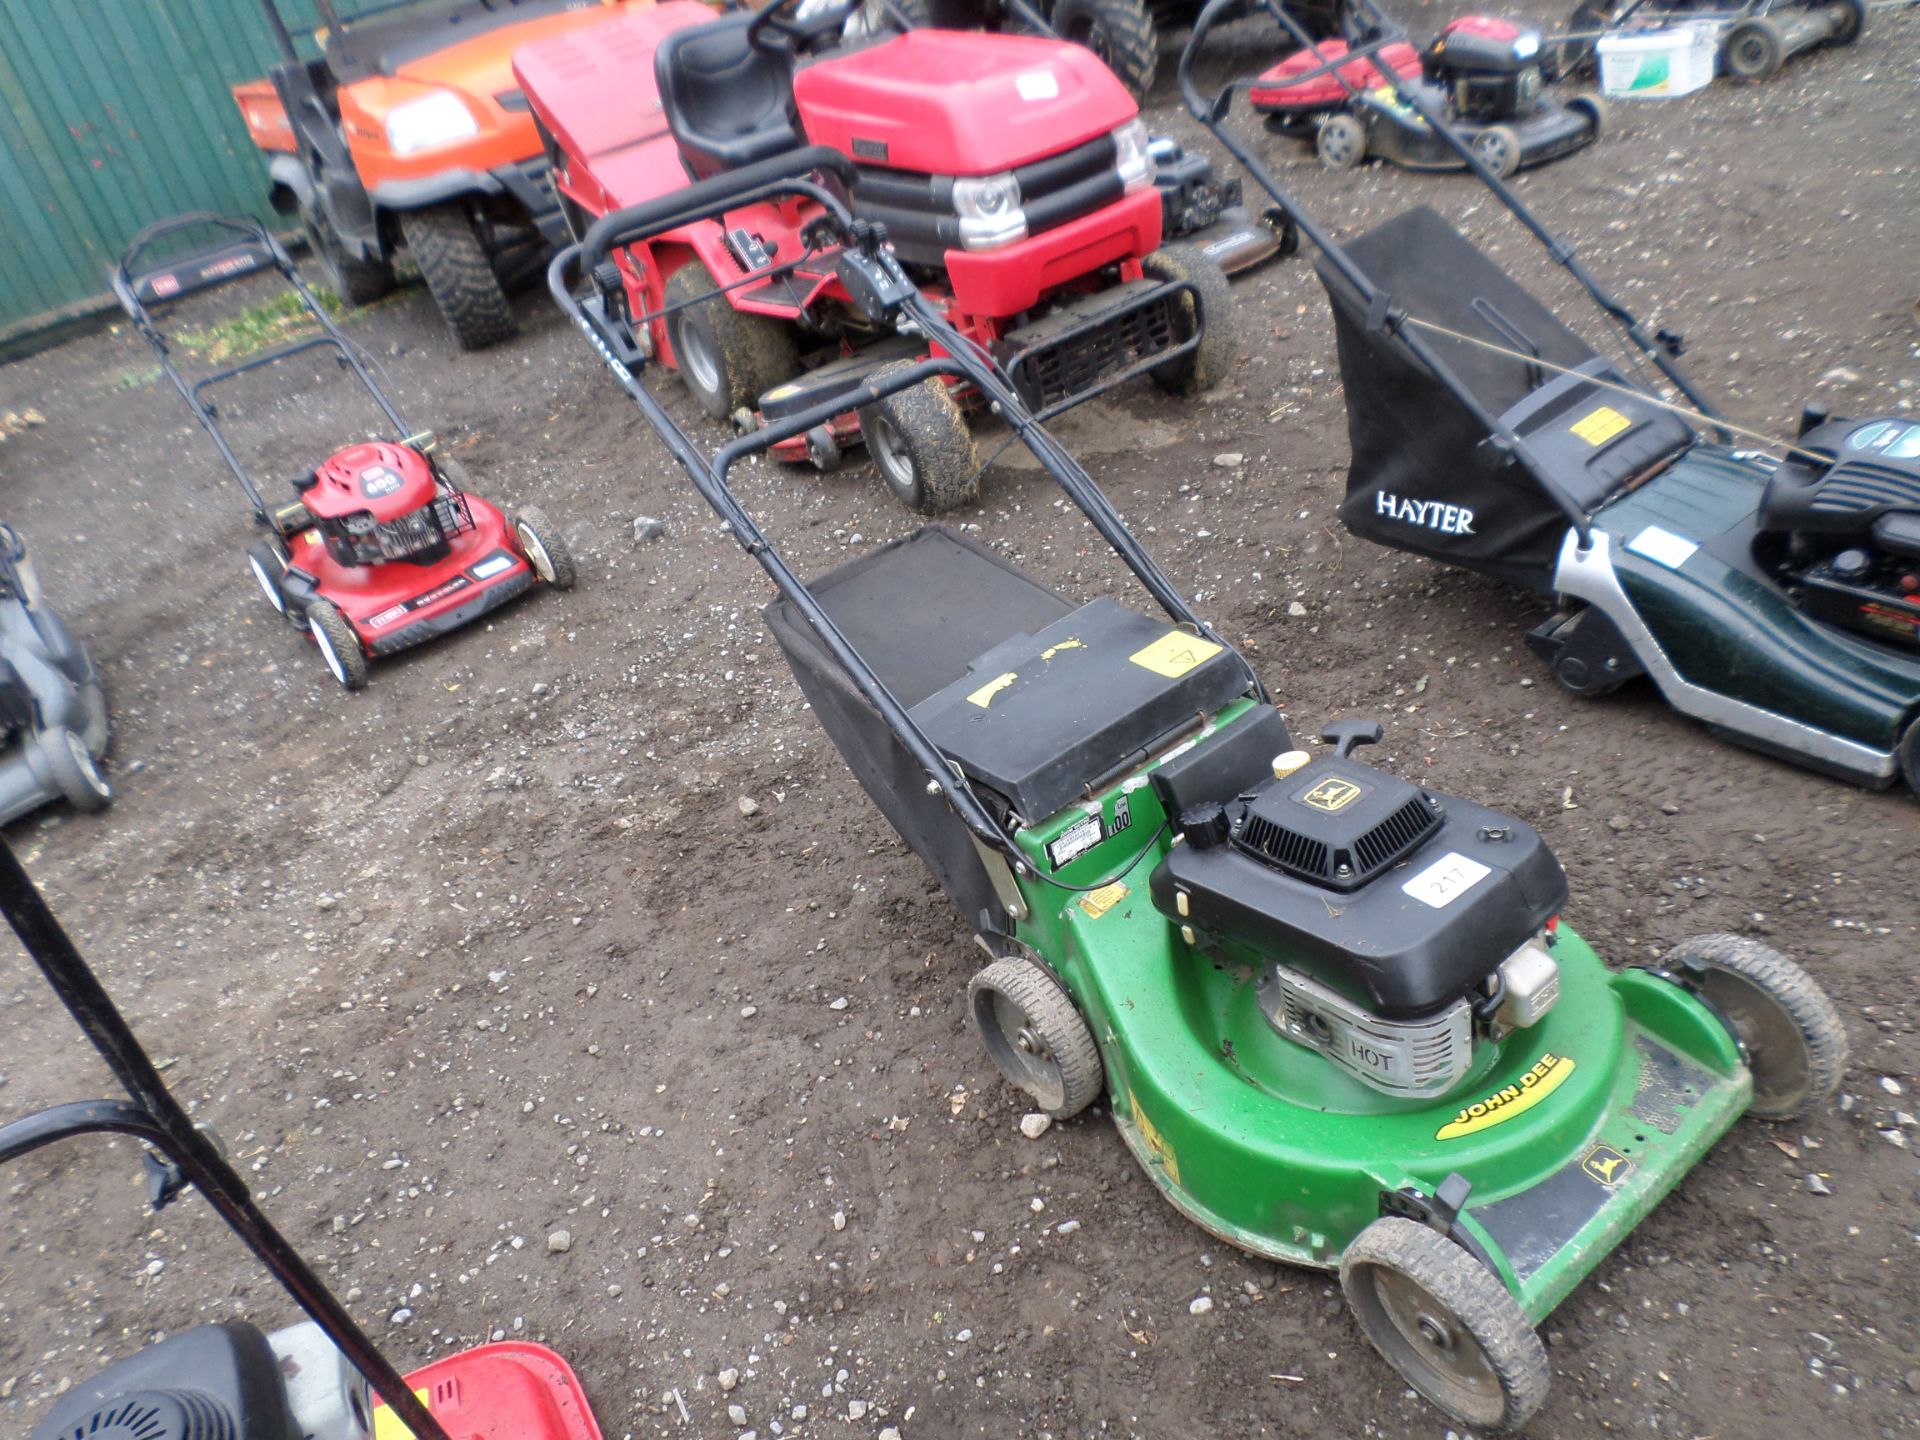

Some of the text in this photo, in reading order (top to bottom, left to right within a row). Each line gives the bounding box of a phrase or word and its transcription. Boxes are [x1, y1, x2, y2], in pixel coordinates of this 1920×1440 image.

[1376, 490, 1477, 534] HAYTER
[1430, 867, 1465, 894] 217
[1351, 1040, 1393, 1071] HOT
[1454, 1083, 1522, 1124] JOHN
